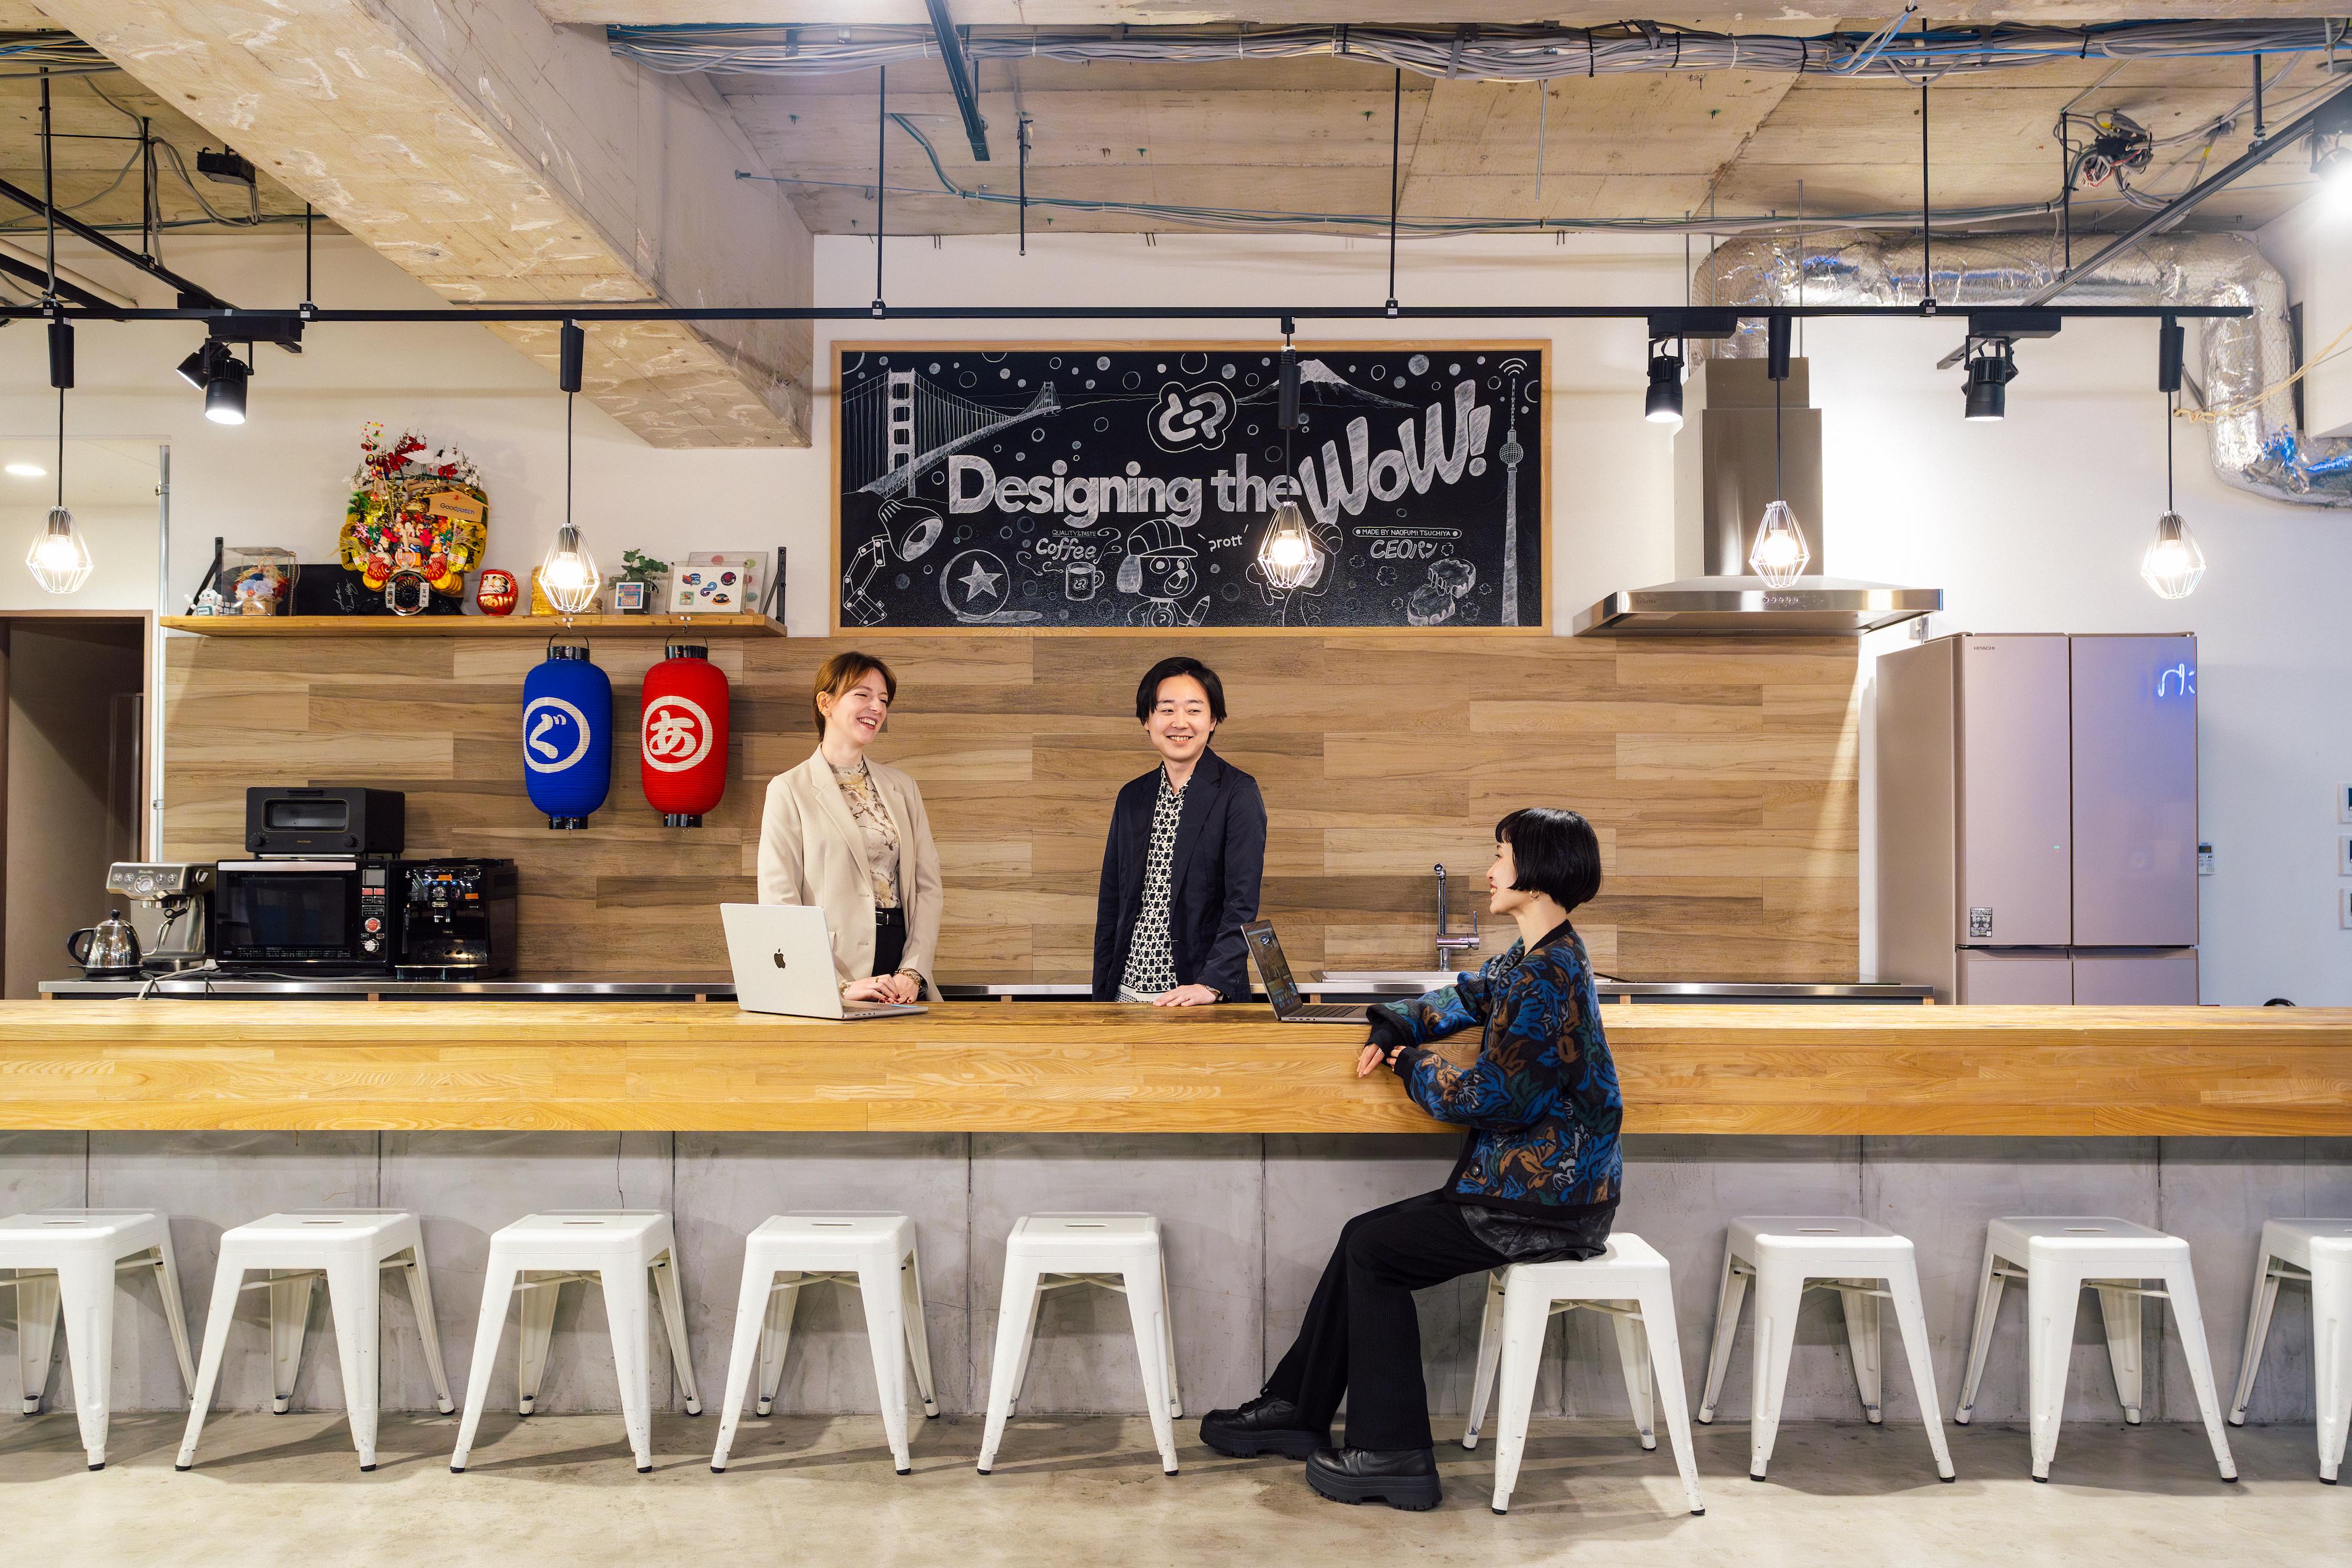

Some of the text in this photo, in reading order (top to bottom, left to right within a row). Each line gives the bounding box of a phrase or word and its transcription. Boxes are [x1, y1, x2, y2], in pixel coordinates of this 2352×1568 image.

[948, 454, 1202, 527] Designing
[1211, 453, 1302, 512] the
[529, 713, 567, 759] ぐ
[649, 710, 697, 757] あ
